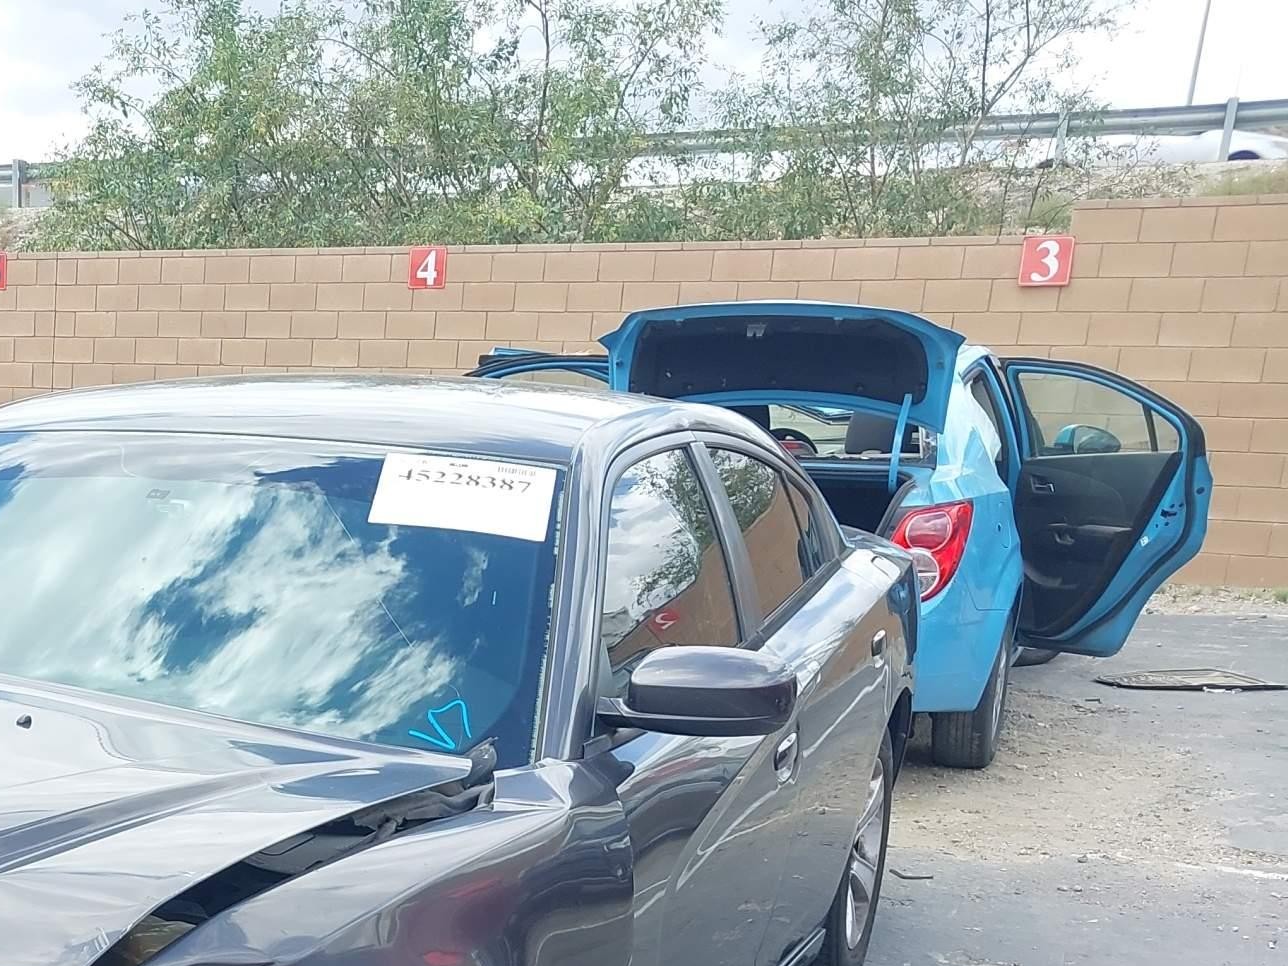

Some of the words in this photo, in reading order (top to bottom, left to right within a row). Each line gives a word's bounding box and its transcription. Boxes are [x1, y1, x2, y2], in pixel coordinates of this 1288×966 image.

[416, 249, 438, 286] 4
[1030, 240, 1060, 282] 3
[398, 468, 532, 493] 45228387
